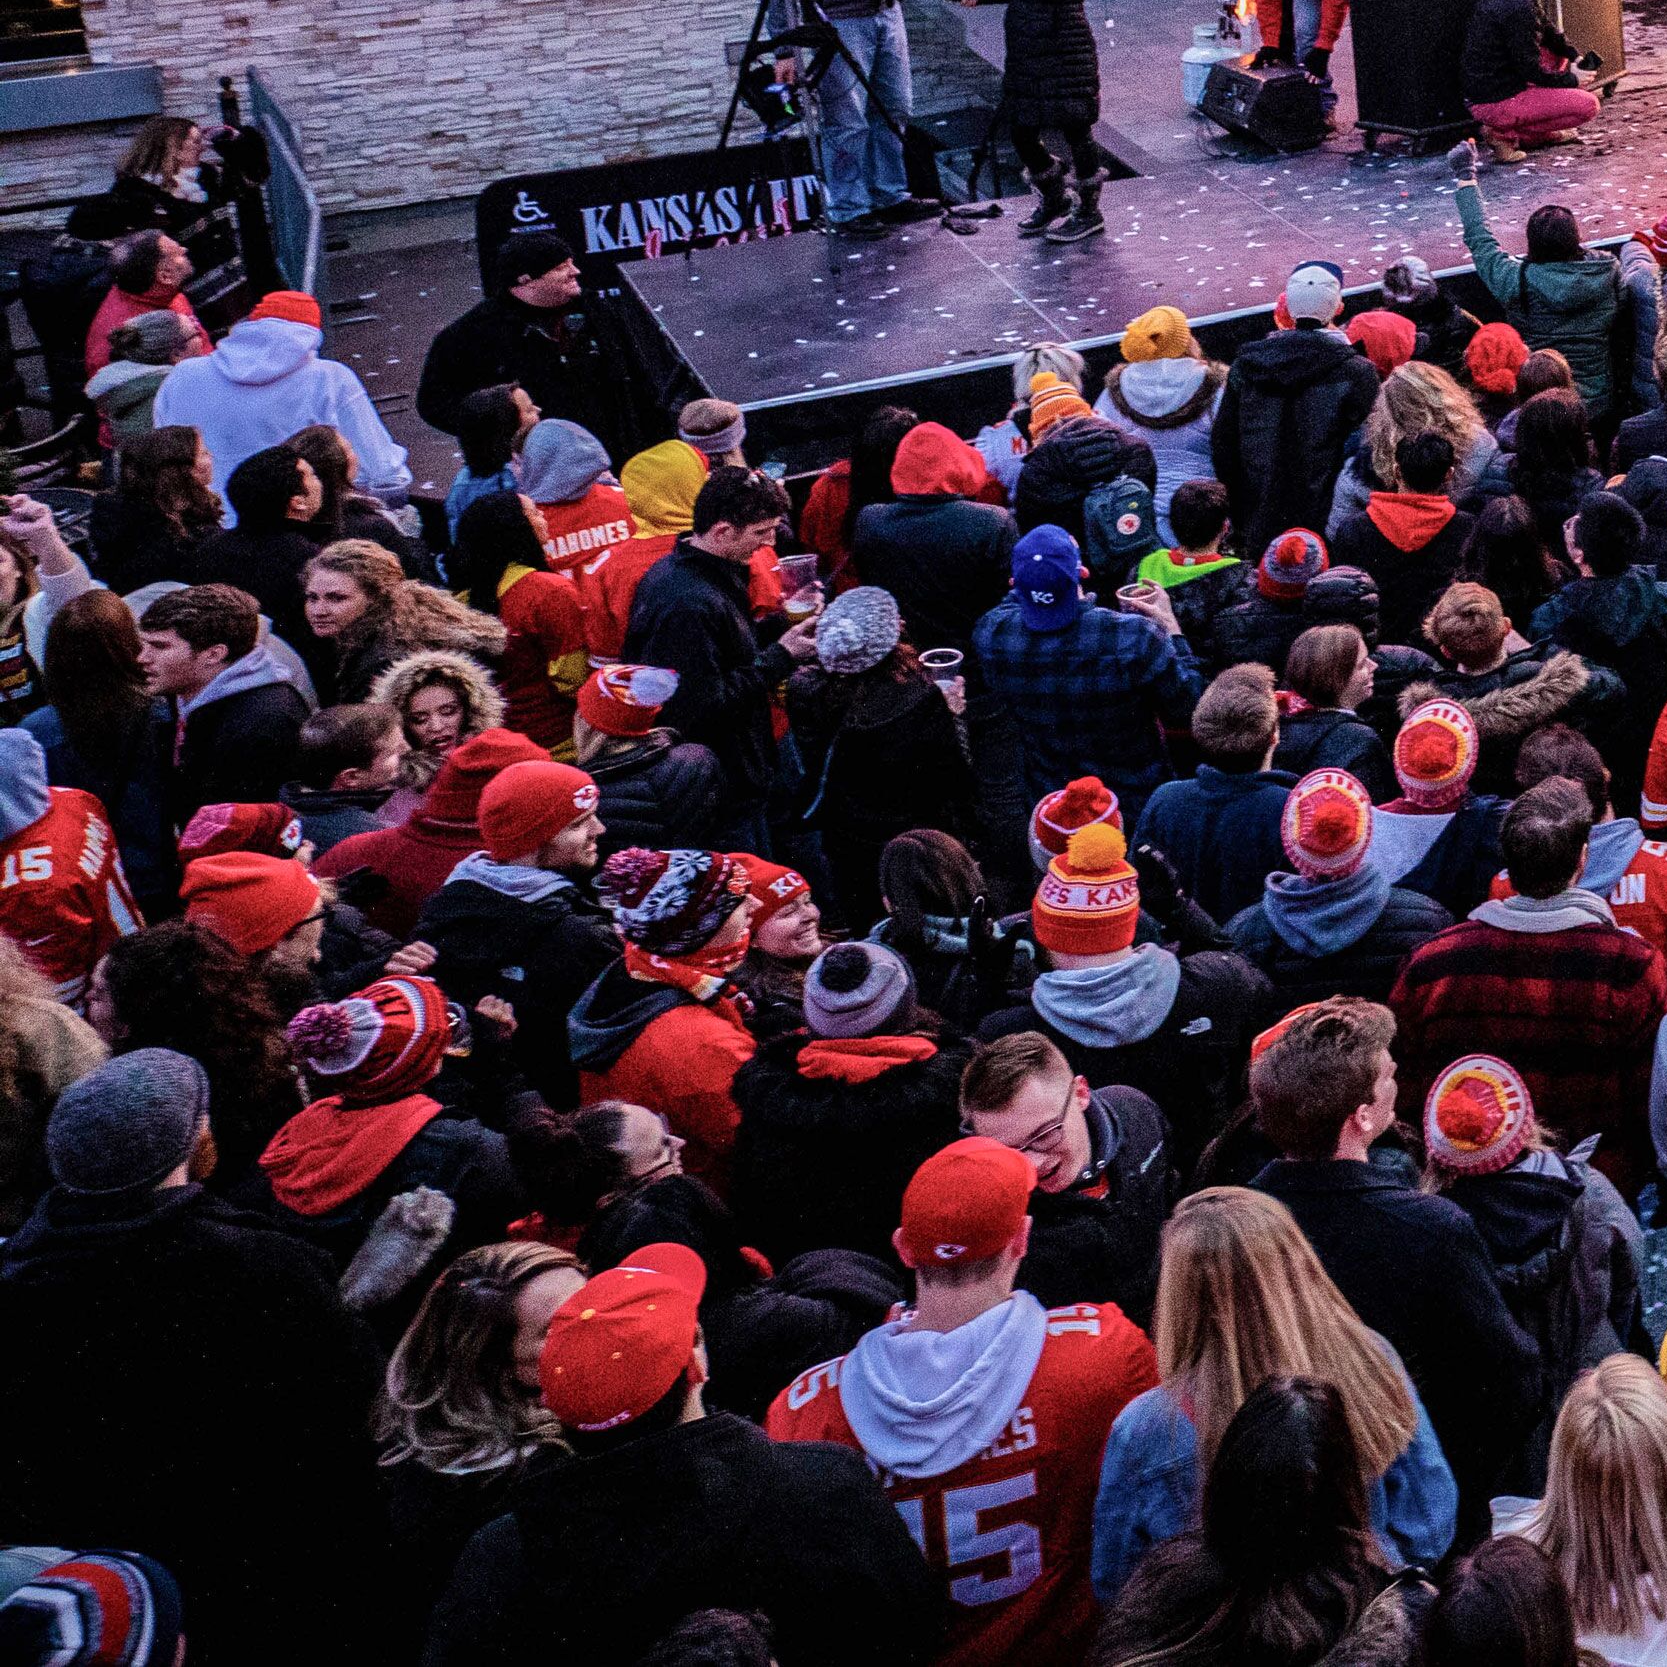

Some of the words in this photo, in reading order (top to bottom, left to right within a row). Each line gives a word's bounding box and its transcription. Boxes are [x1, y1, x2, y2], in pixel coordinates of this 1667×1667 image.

[581, 185, 739, 253] KANSAS
[542, 520, 630, 560] MAHOMES
[1031, 590, 1054, 604] KC
